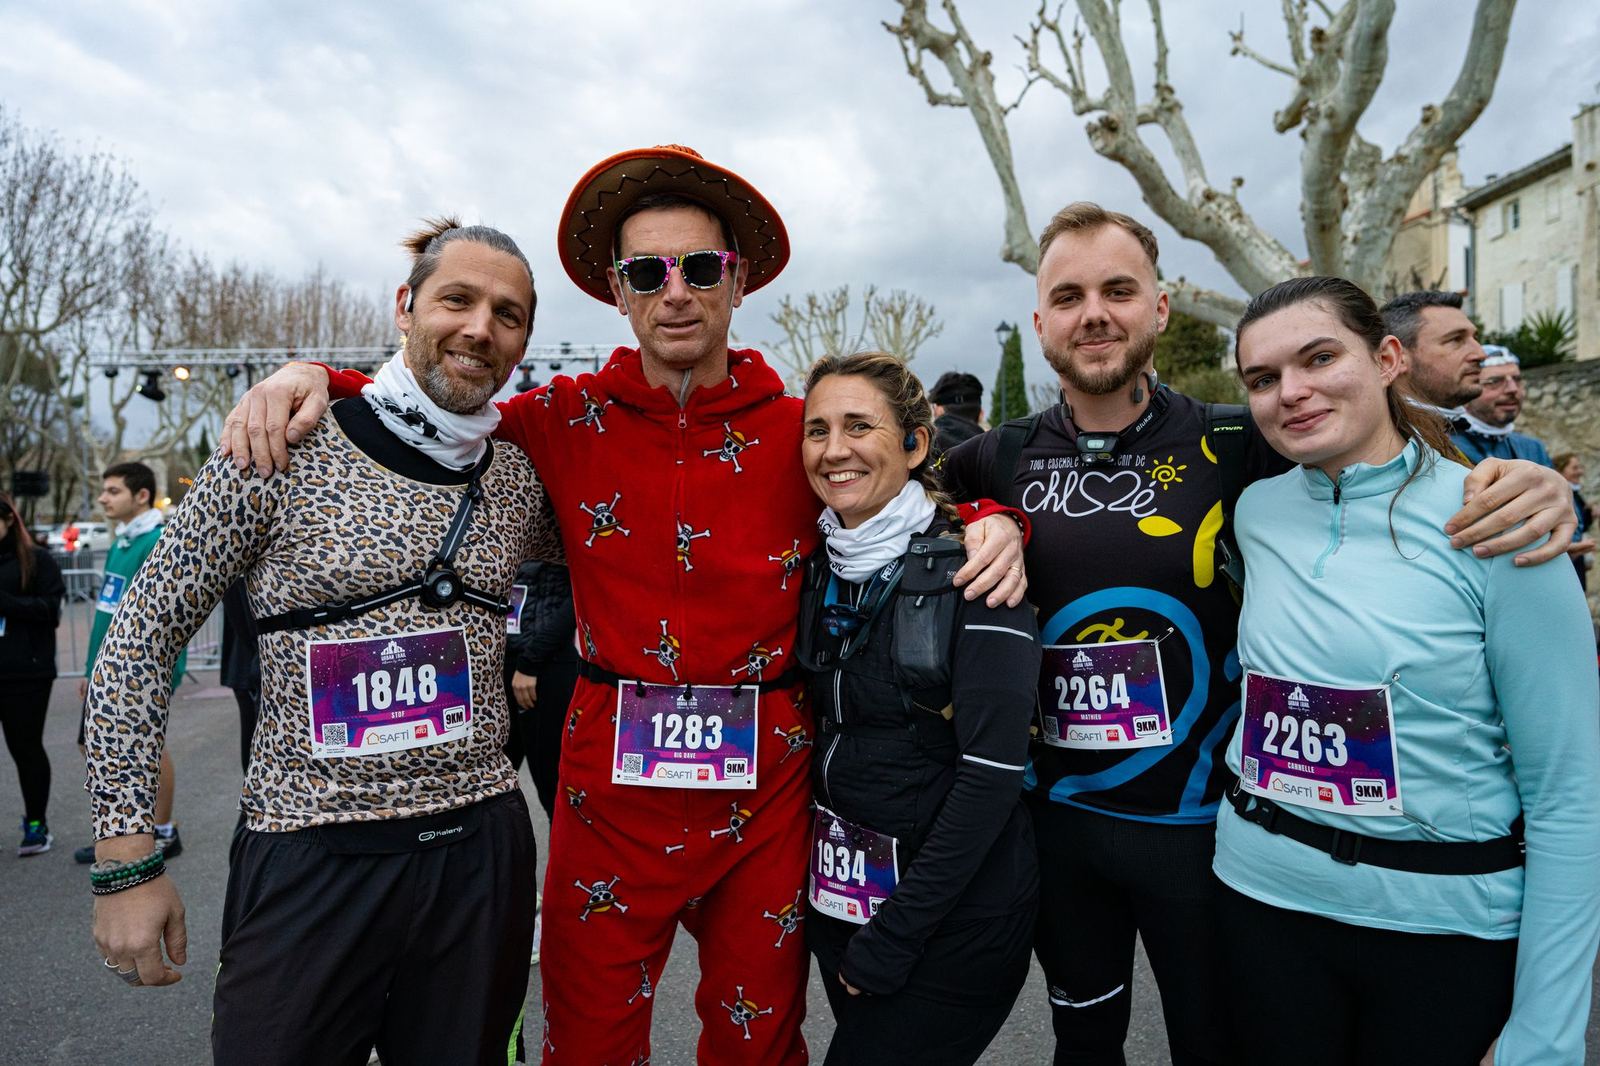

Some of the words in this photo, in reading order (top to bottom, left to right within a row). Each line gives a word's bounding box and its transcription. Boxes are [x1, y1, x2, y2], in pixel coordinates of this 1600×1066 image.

[1135, 412, 1153, 432] Blukar
[352, 664, 439, 712] 1848
[1055, 673, 1131, 711] 2264
[391, 711, 406, 719] STOF
[445, 711, 464, 725] 9KM
[1080, 713, 1102, 721] MATHIEU
[651, 713, 723, 750] 1283
[1136, 720, 1158, 732] 9KM
[1262, 711, 1348, 767] 2263
[726, 763, 745, 774] 9KM
[1355, 785, 1383, 798] 9KM
[436, 826, 463, 836] Kalenji
[817, 838, 867, 887] 1934
